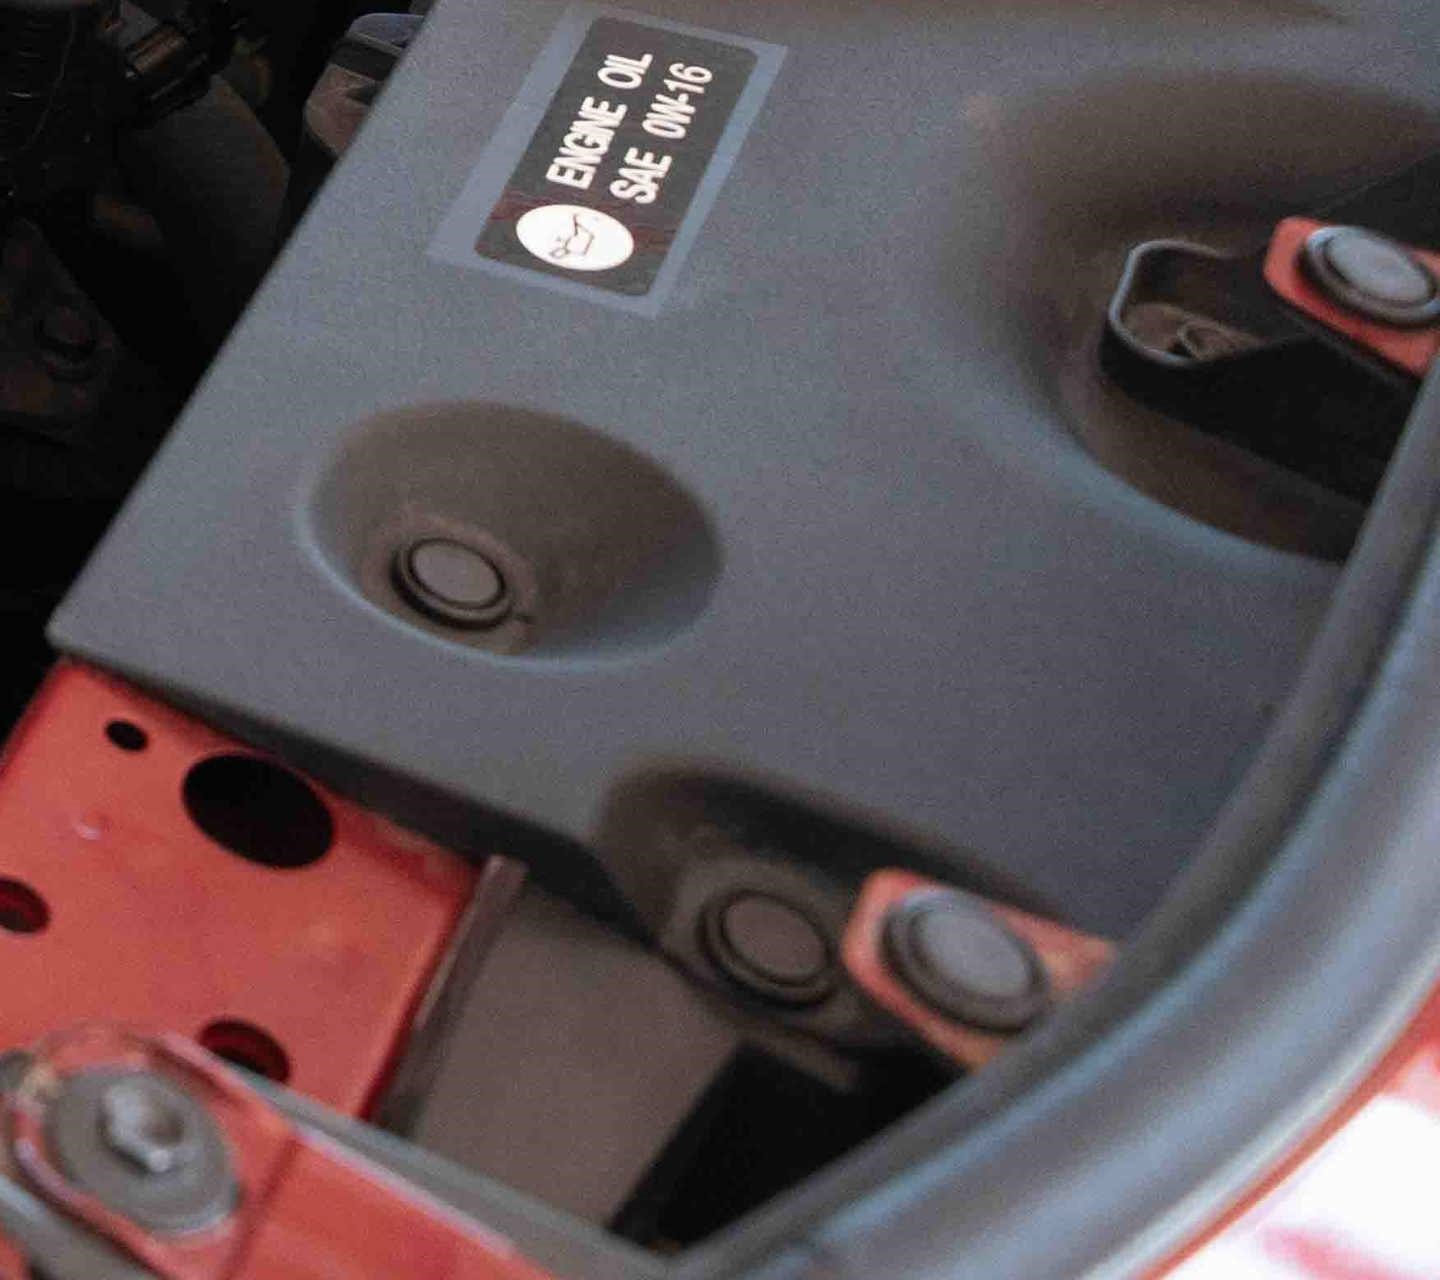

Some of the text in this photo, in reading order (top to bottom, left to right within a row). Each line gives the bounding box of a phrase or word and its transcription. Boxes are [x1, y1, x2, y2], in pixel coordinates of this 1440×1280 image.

[545, 50, 654, 191] ENGINE OIL
[609, 62, 714, 205] SAE 0W-16
